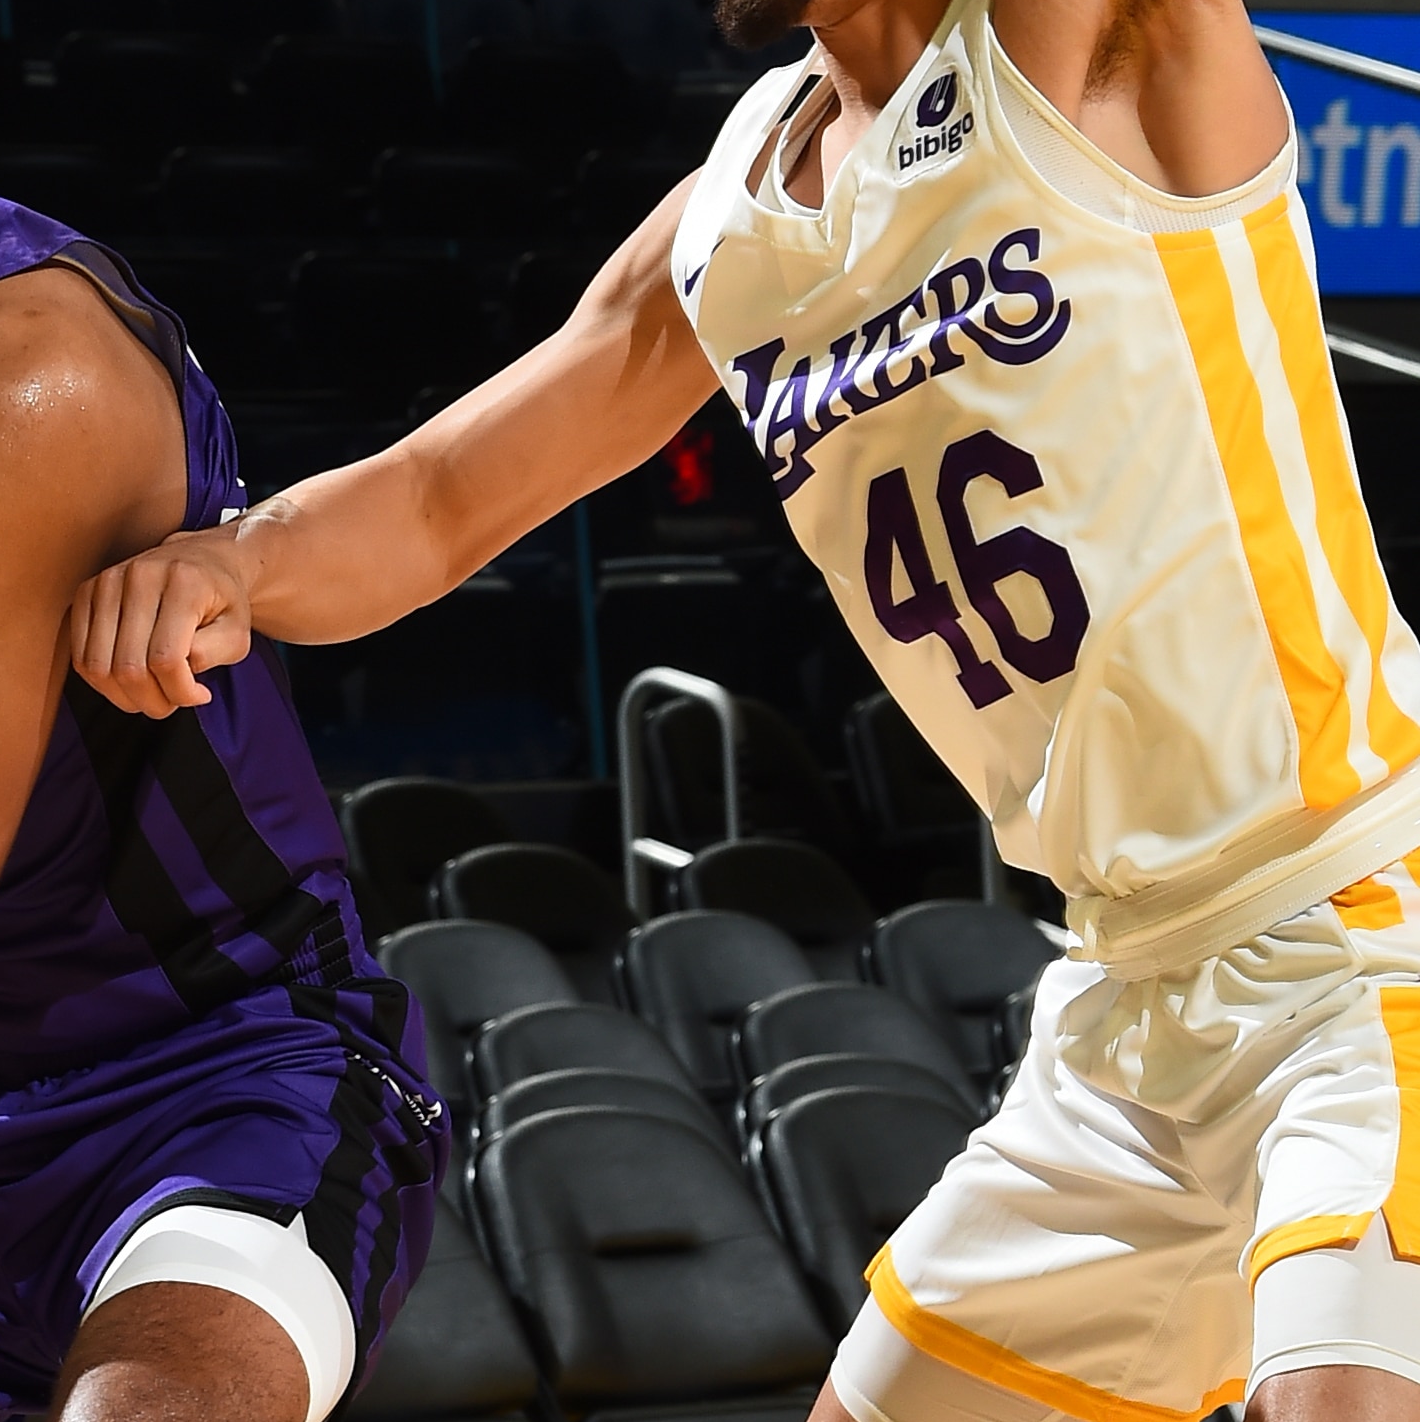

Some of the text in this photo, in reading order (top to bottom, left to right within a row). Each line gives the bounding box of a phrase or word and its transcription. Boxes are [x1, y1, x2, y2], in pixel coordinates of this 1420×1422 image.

[898, 111, 975, 171] bibigo
[731, 226, 1072, 504] LAKERS
[863, 428, 1092, 710] 46
